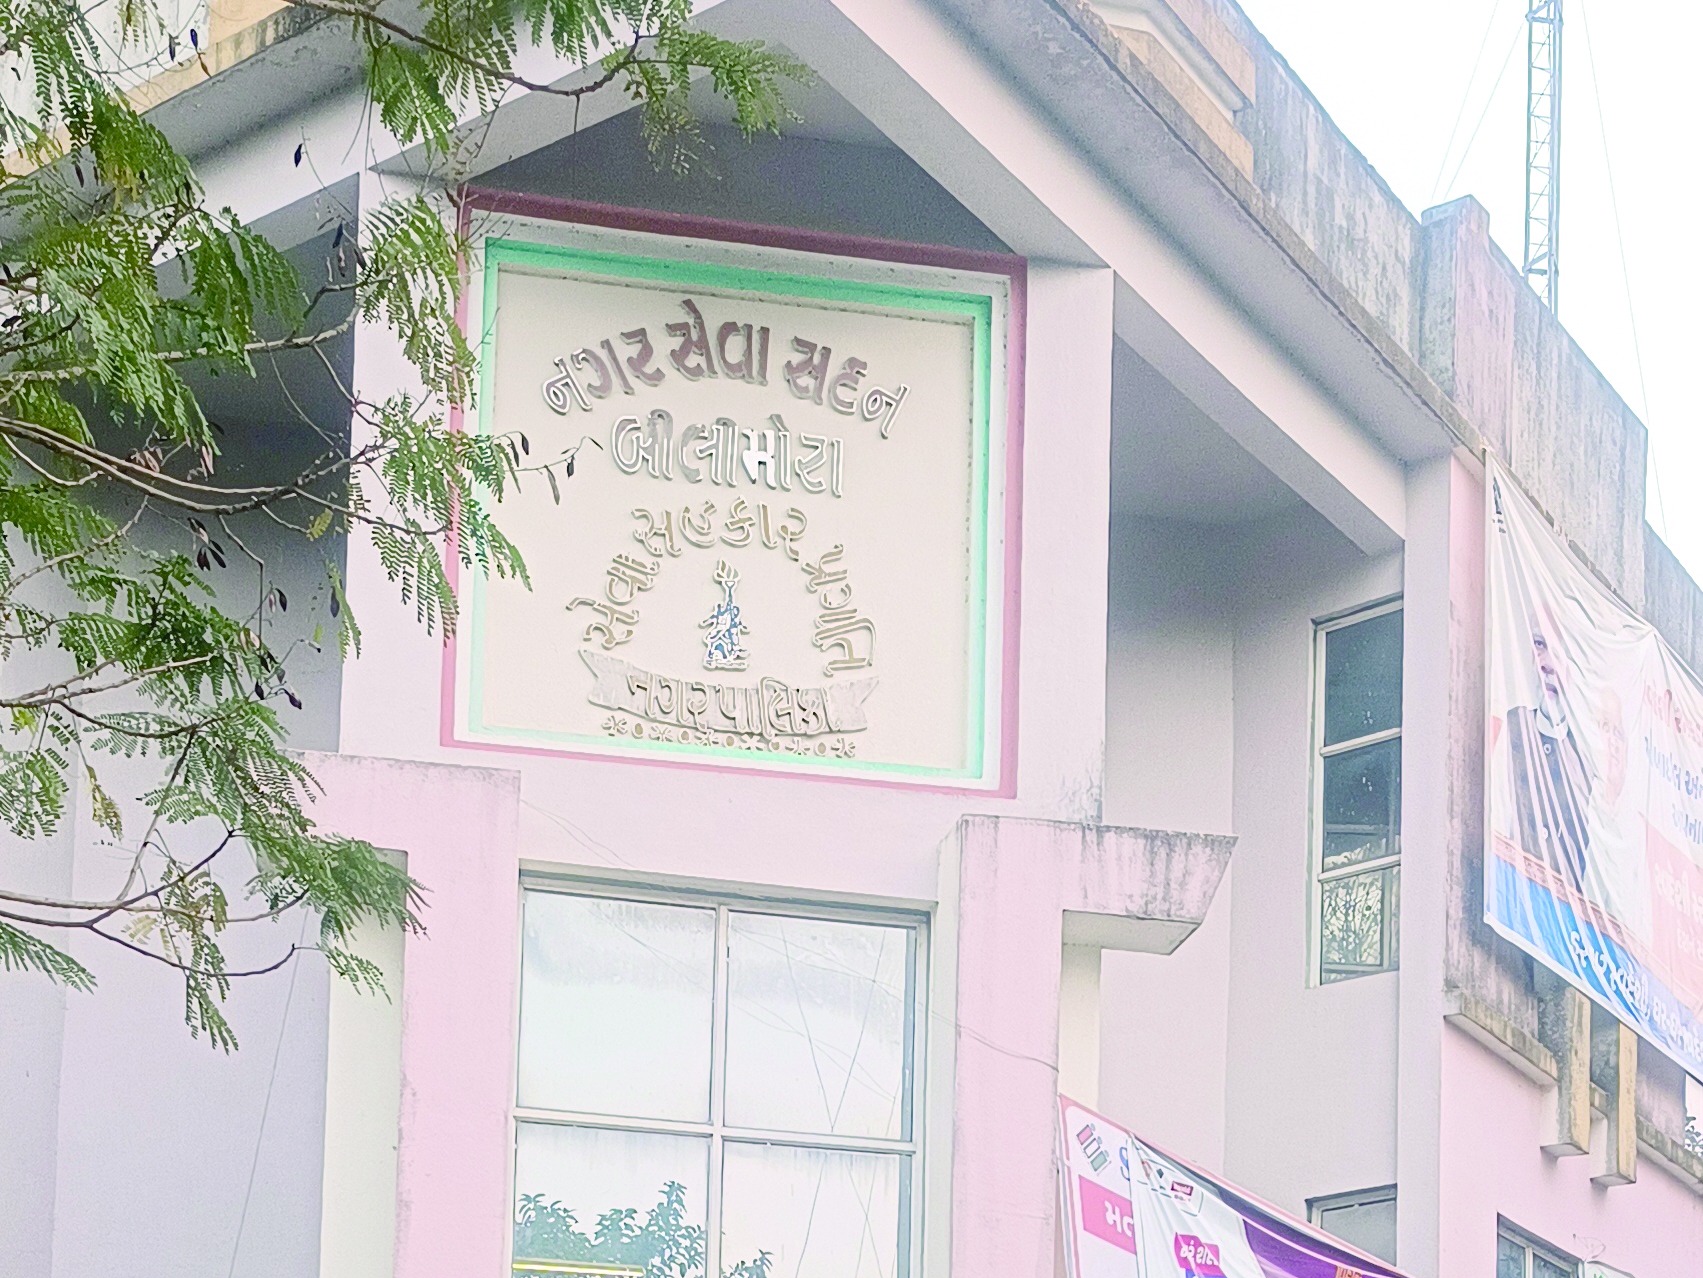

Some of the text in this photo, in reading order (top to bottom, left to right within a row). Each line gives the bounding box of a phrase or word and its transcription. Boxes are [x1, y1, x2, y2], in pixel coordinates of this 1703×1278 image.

[542, 298, 912, 439] નગર સેવા સદન
[610, 407, 846, 497] બીલીમોરા
[566, 549, 662, 650] સેવા
[631, 496, 808, 562] સહકાર
